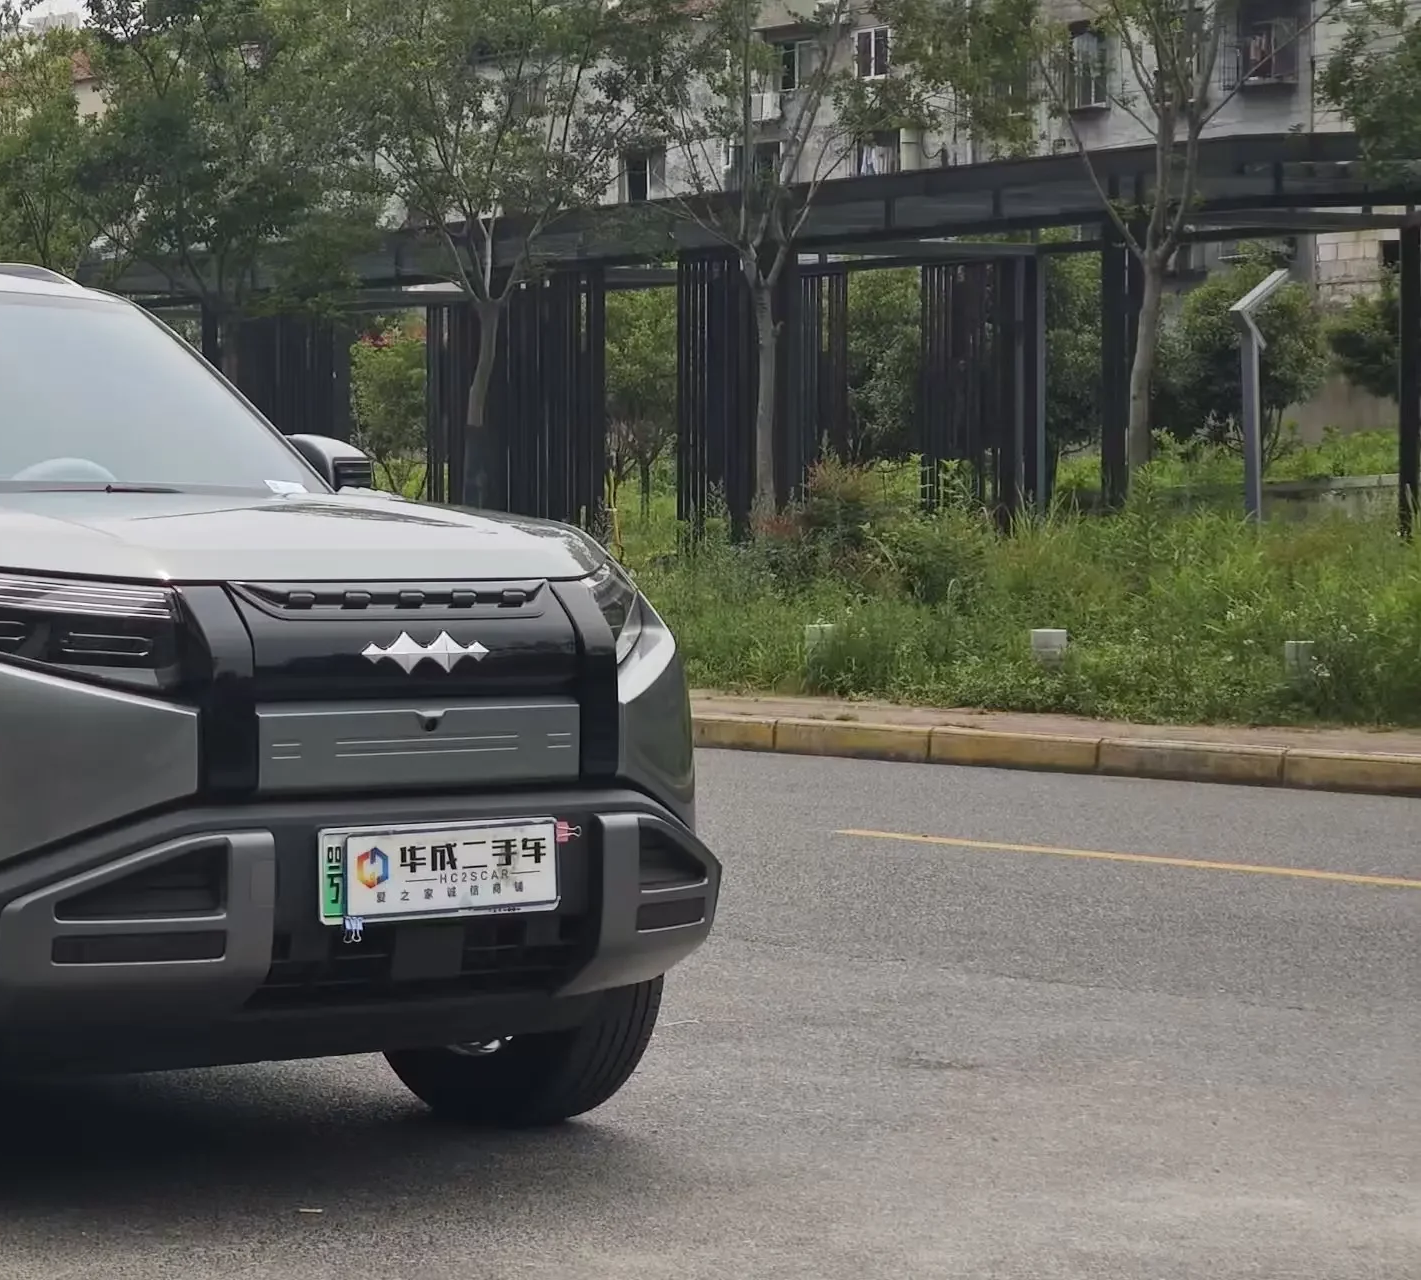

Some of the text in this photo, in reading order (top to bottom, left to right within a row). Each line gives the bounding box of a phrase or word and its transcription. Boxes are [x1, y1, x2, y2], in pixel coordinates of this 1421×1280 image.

[400, 838, 546, 873] 华成二手车
[439, 871, 509, 884] HC2SCAR
